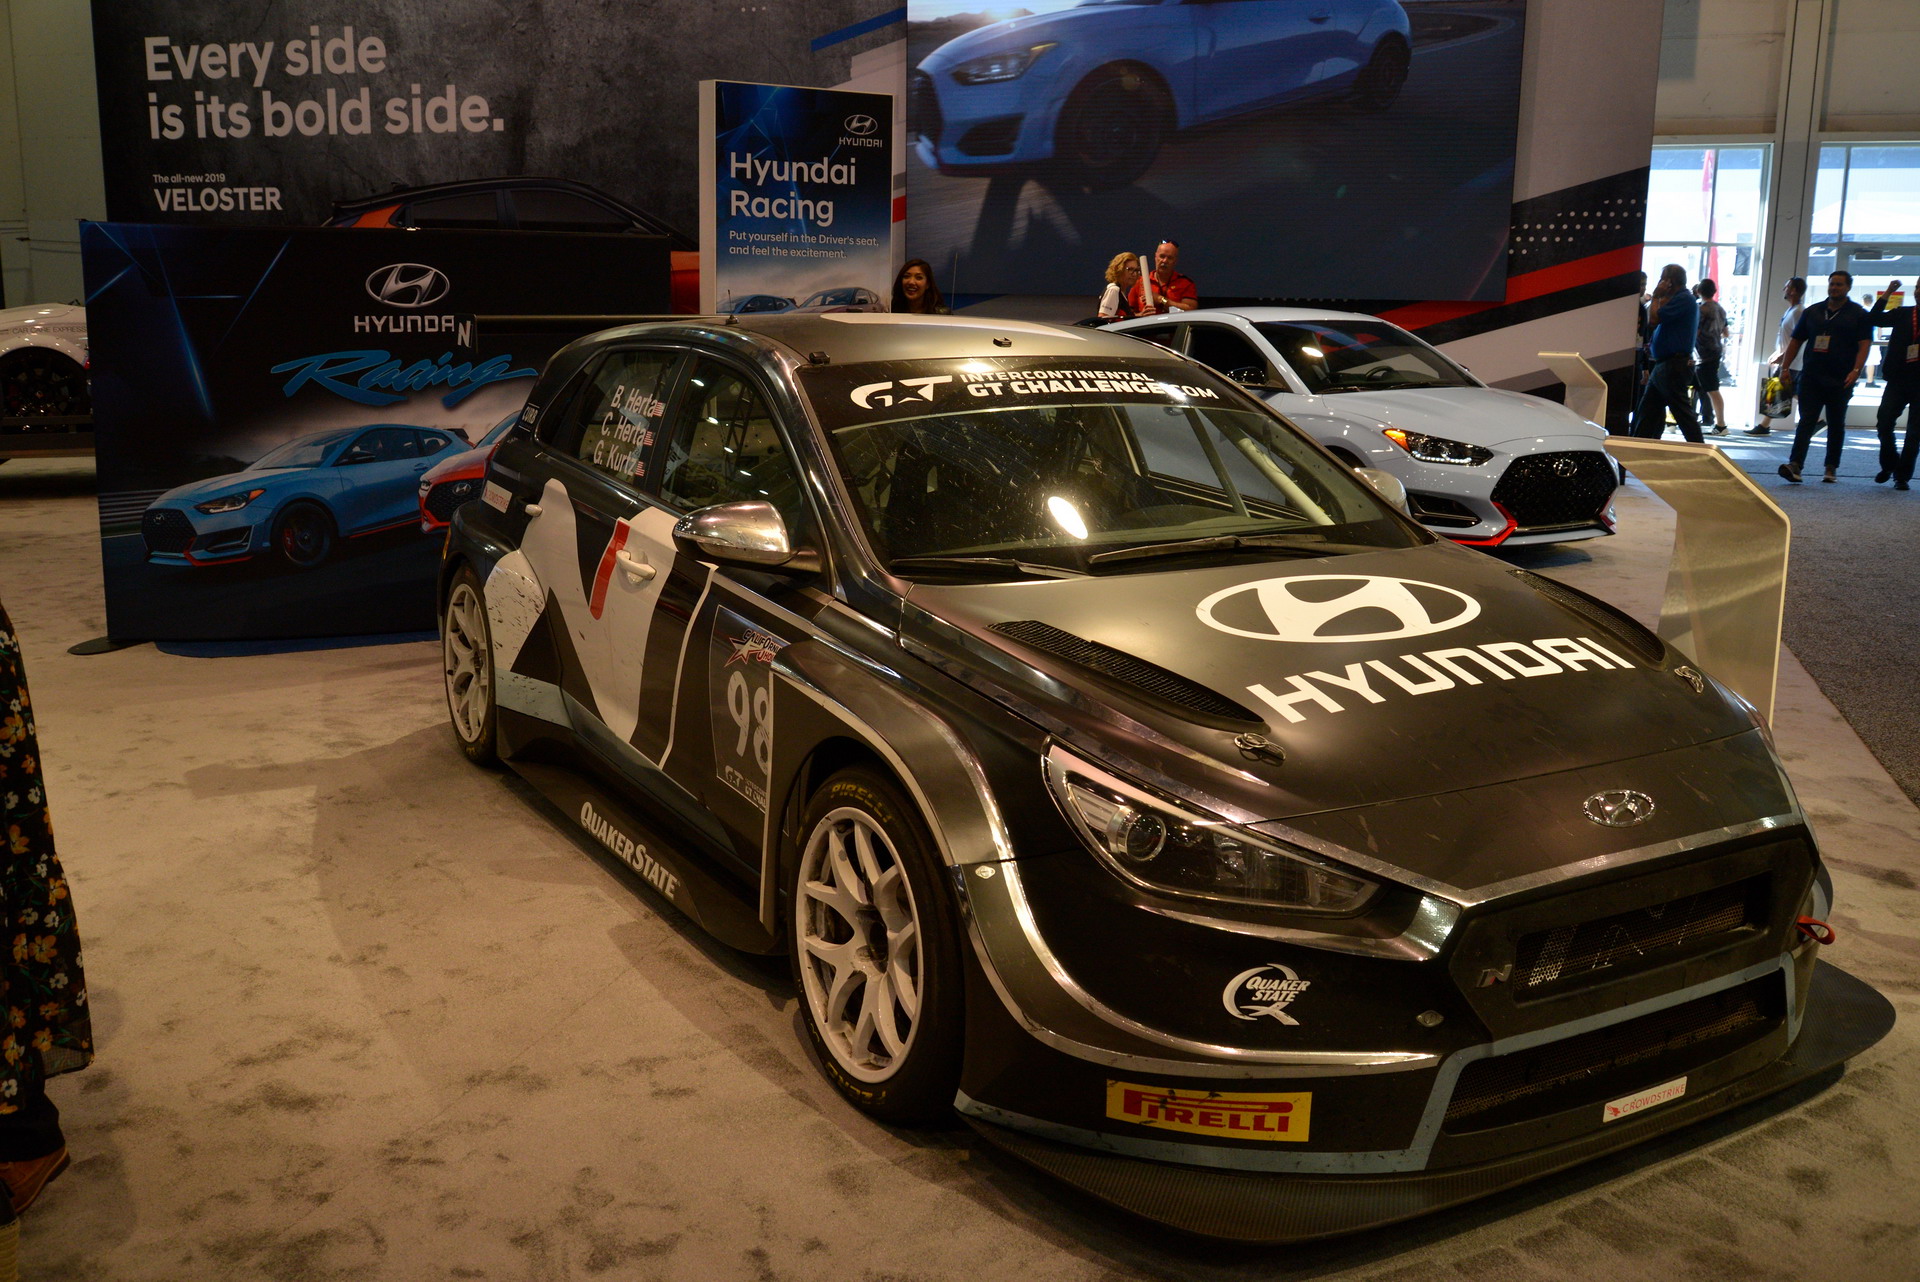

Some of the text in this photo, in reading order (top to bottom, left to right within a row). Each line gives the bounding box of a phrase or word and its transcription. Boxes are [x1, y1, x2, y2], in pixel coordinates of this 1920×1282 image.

[144, 25, 387, 87] Every side
[148, 83, 504, 140] is its bold side.
[839, 136, 883, 149] HYUNDAI
[152, 173, 226, 184] The all-new 2019
[730, 151, 856, 187] Hyundai
[153, 186, 283, 212] VELOSTER
[730, 189, 834, 228] Racing
[729, 230, 880, 248] Put yourself in the Driver's seat,
[729, 245, 847, 259] and feel the excitement.
[353, 315, 455, 333] HYUNDA
[270, 350, 539, 407] Racing
[960, 370, 1154, 383] INTERCONTINENTAL
[967, 382, 1003, 398] GT
[610, 384, 658, 418] B. Herta
[601, 411, 647, 446] C. Herta
[593, 439, 605, 465] G.
[606, 444, 638, 476] Kurtz
[1245, 637, 1636, 724] HYUNDAI
[727, 670, 771, 776] 98
[1245, 975, 1311, 992] QUAKER
[1251, 990, 1300, 1002] STATE
[1123, 1088, 1294, 1133] PIRELLI
[1622, 1083, 1686, 1113] CROWDSTRIKE
